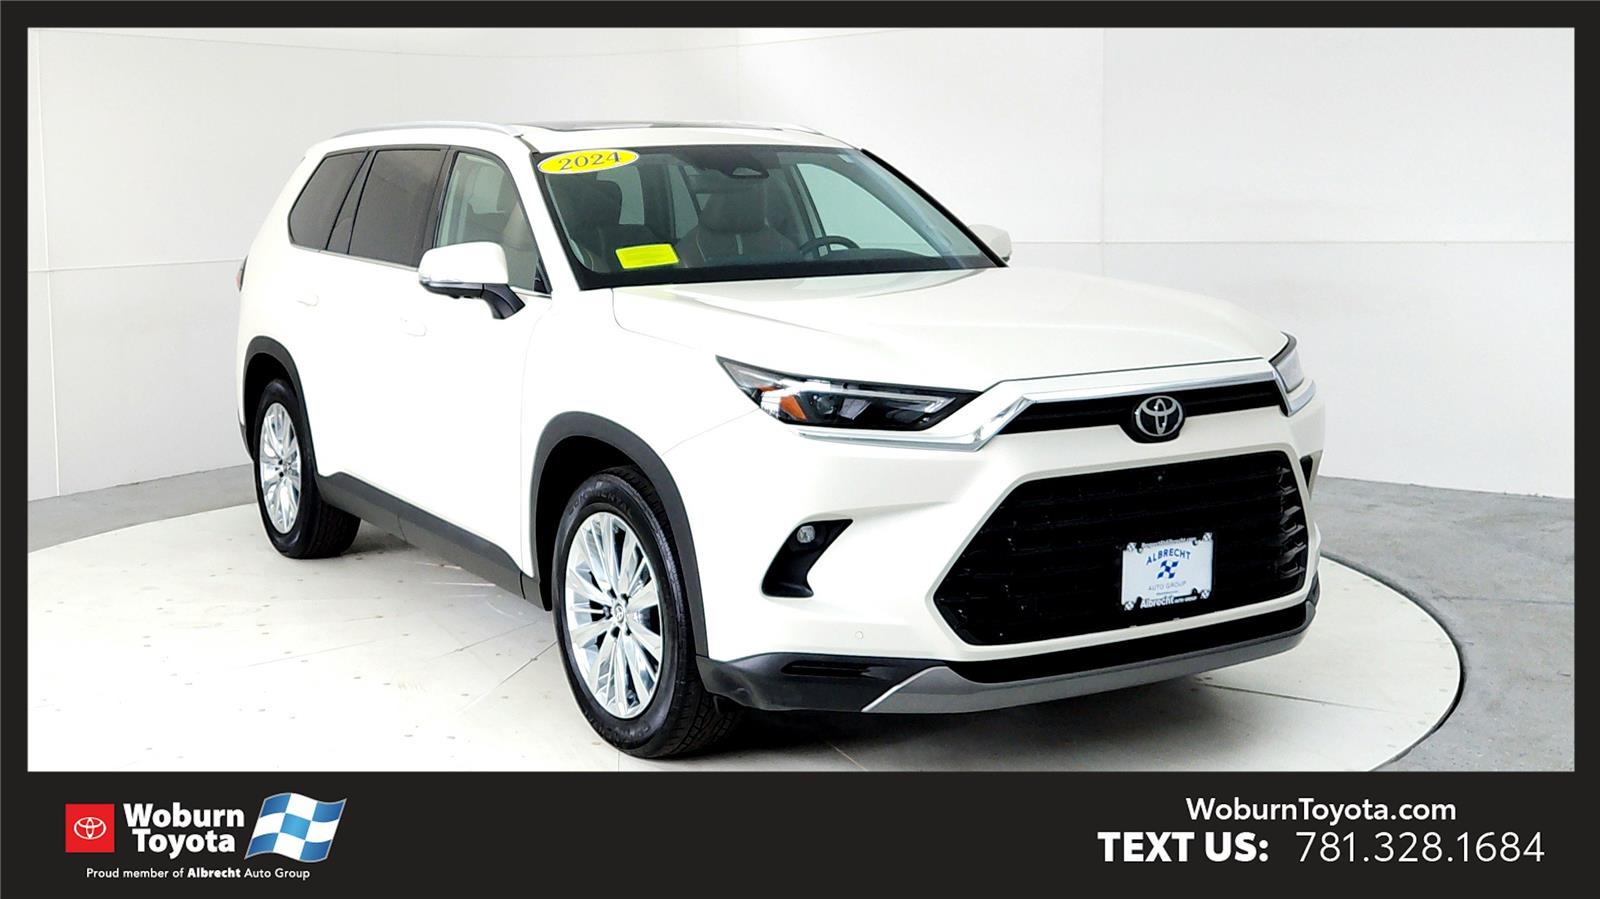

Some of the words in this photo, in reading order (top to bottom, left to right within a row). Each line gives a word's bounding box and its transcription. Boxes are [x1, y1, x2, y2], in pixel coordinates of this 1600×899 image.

[558, 152, 621, 171] 2024
[1146, 548, 1191, 566] ALBRECHT
[1140, 595, 1174, 609] Albrecht
